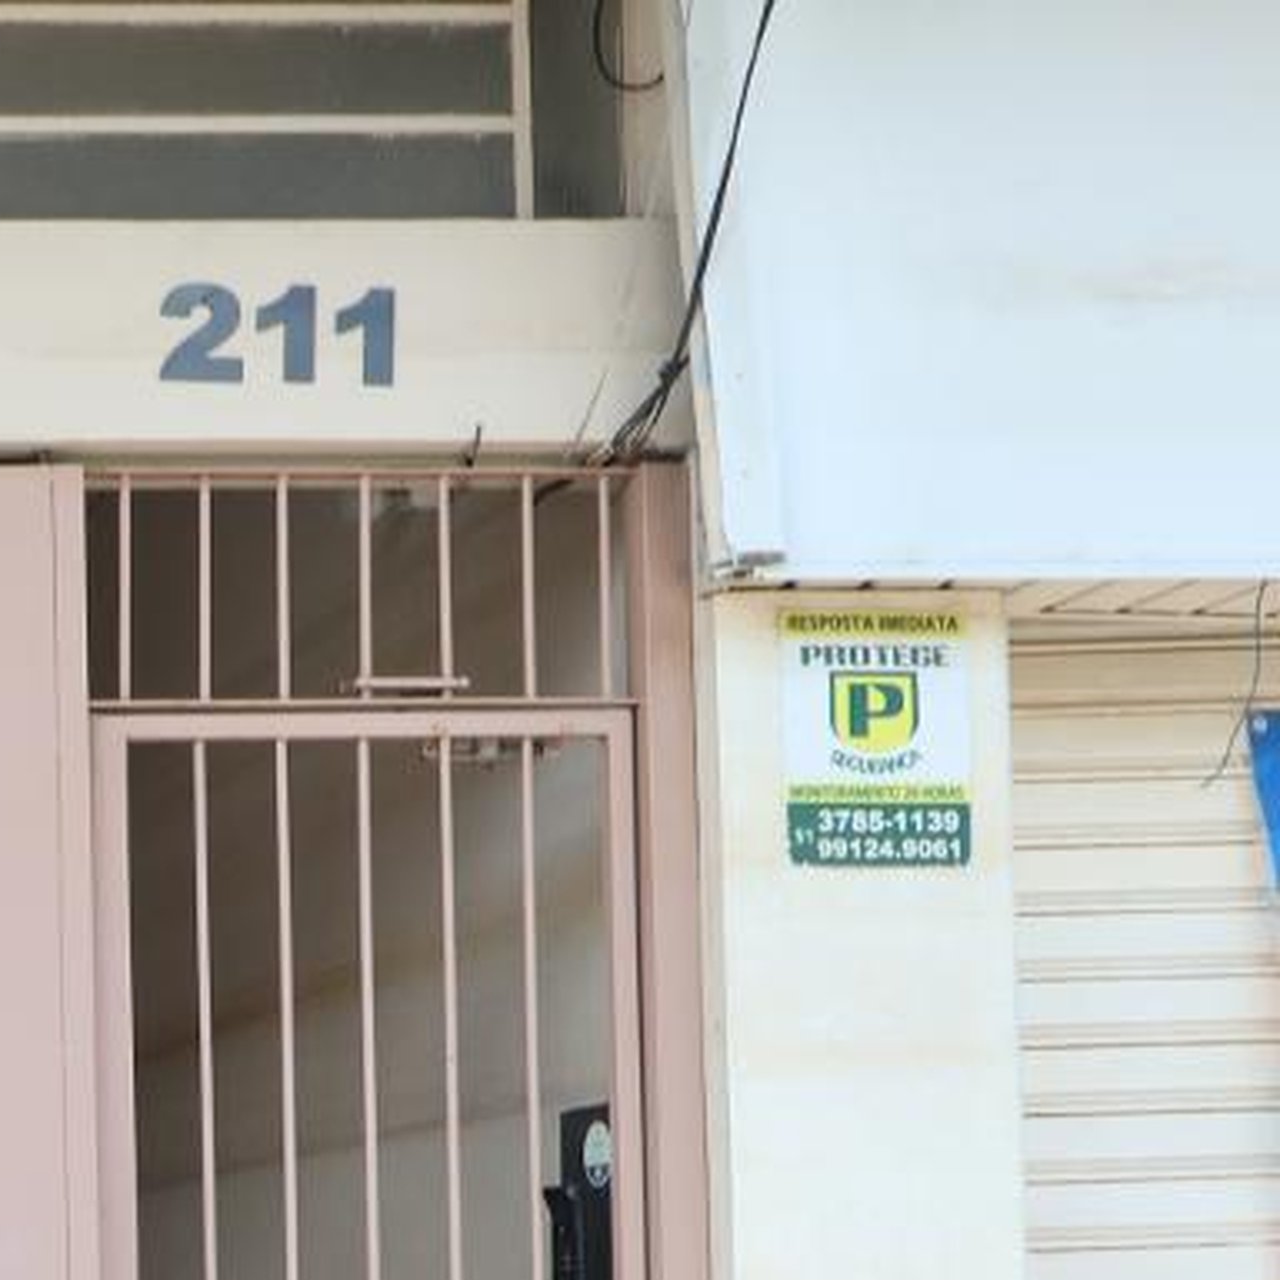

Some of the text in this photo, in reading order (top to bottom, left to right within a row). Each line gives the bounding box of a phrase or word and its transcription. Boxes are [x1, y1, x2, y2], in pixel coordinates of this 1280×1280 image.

[159, 281, 395, 386] 211
[787, 614, 958, 632] RESPOSTA IMEDIATA
[799, 644, 951, 667] PROTEGE
[849, 683, 905, 737] P
[818, 809, 961, 833] 3785-1139
